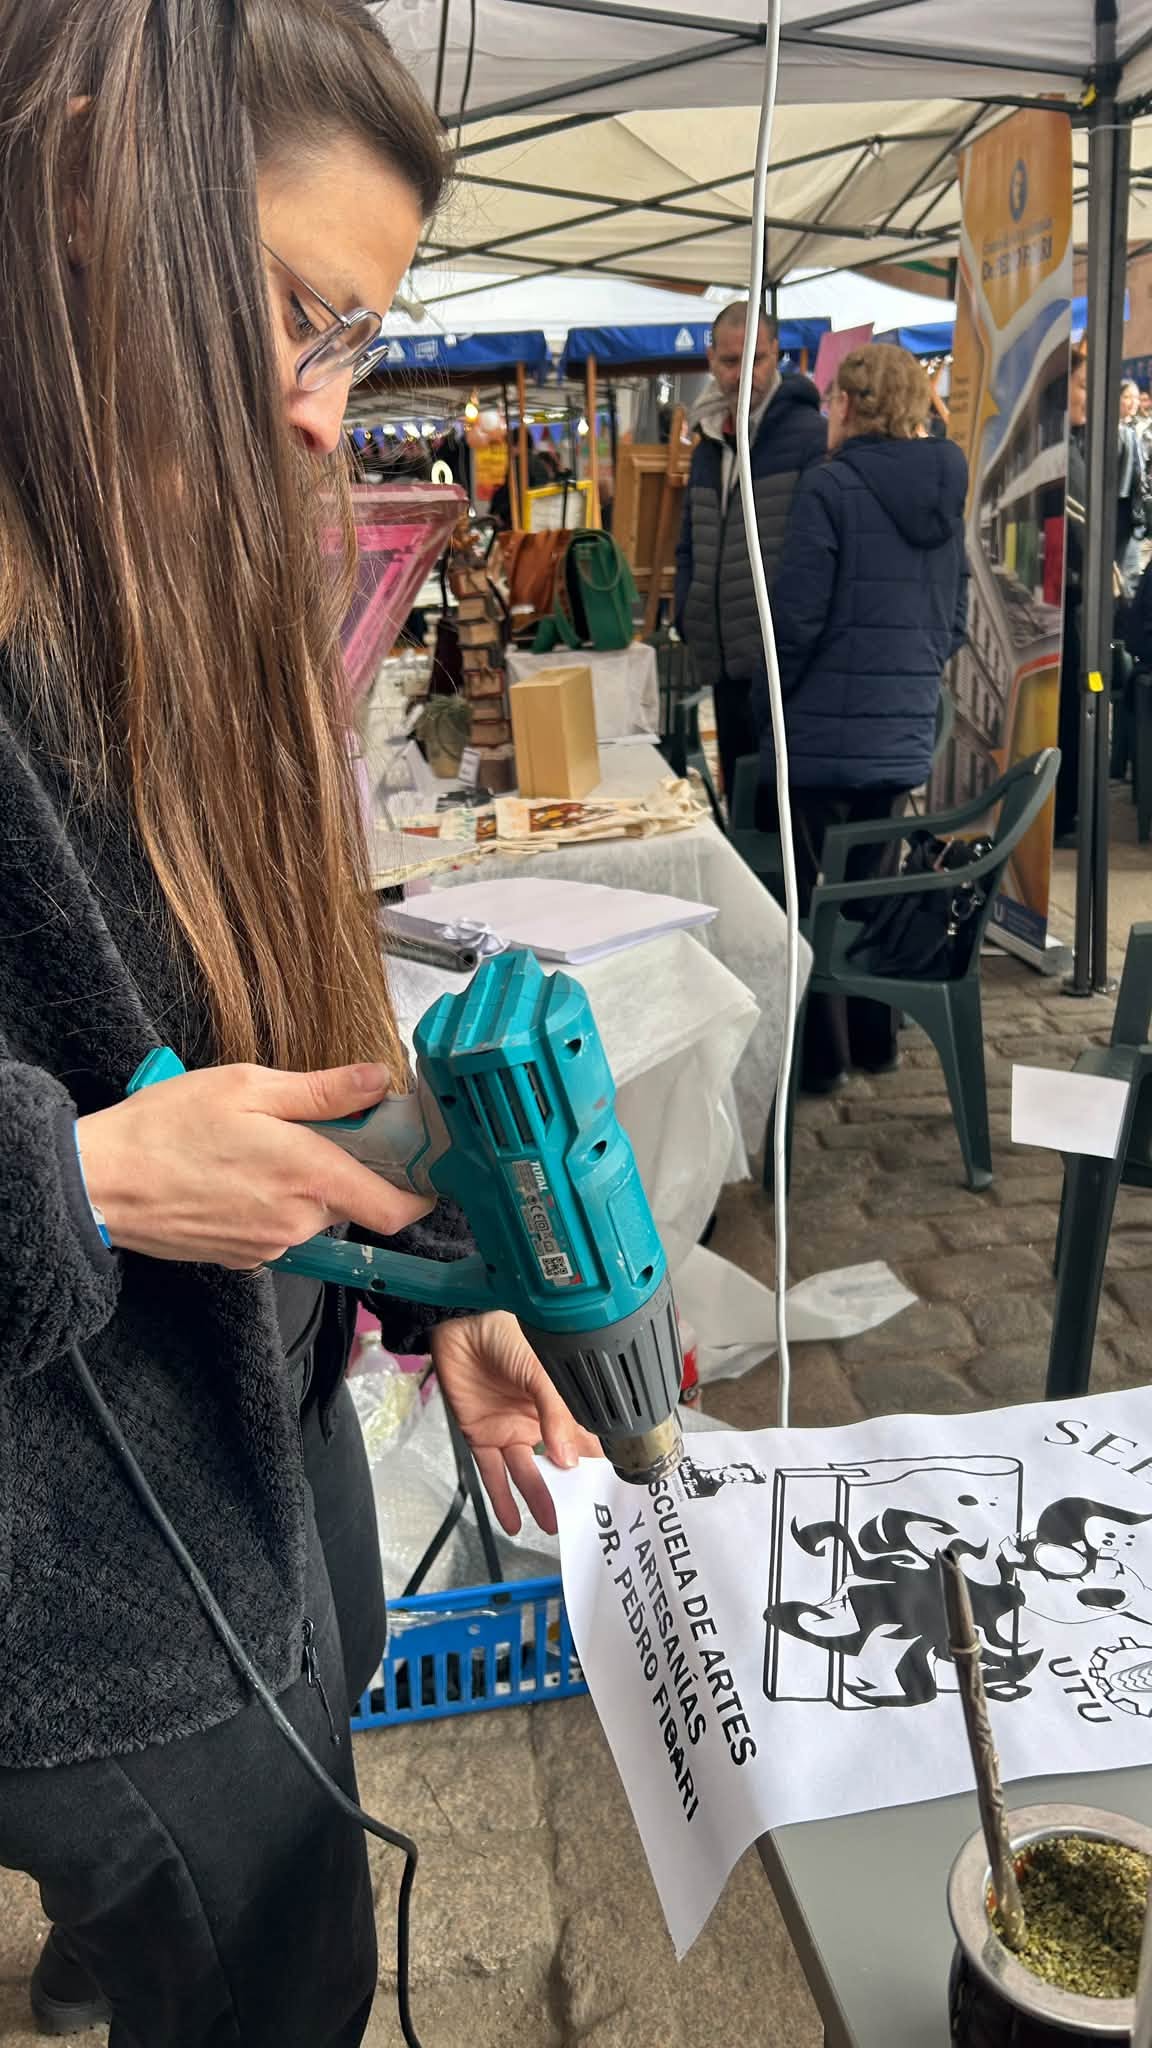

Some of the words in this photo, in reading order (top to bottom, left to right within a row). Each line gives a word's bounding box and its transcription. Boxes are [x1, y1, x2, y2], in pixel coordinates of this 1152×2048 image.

[629, 1510, 645, 1534] Y
[648, 1479, 698, 1592] SCUELA
[635, 1538, 706, 1745] ARTESANÍAS
[683, 1594, 718, 1641] DE
[614, 1566, 658, 1681] PEDRO
[653, 1682, 699, 1822] FIGARI
[699, 1650, 758, 1766] ARTES
[1048, 1656, 1113, 1723] UTU
